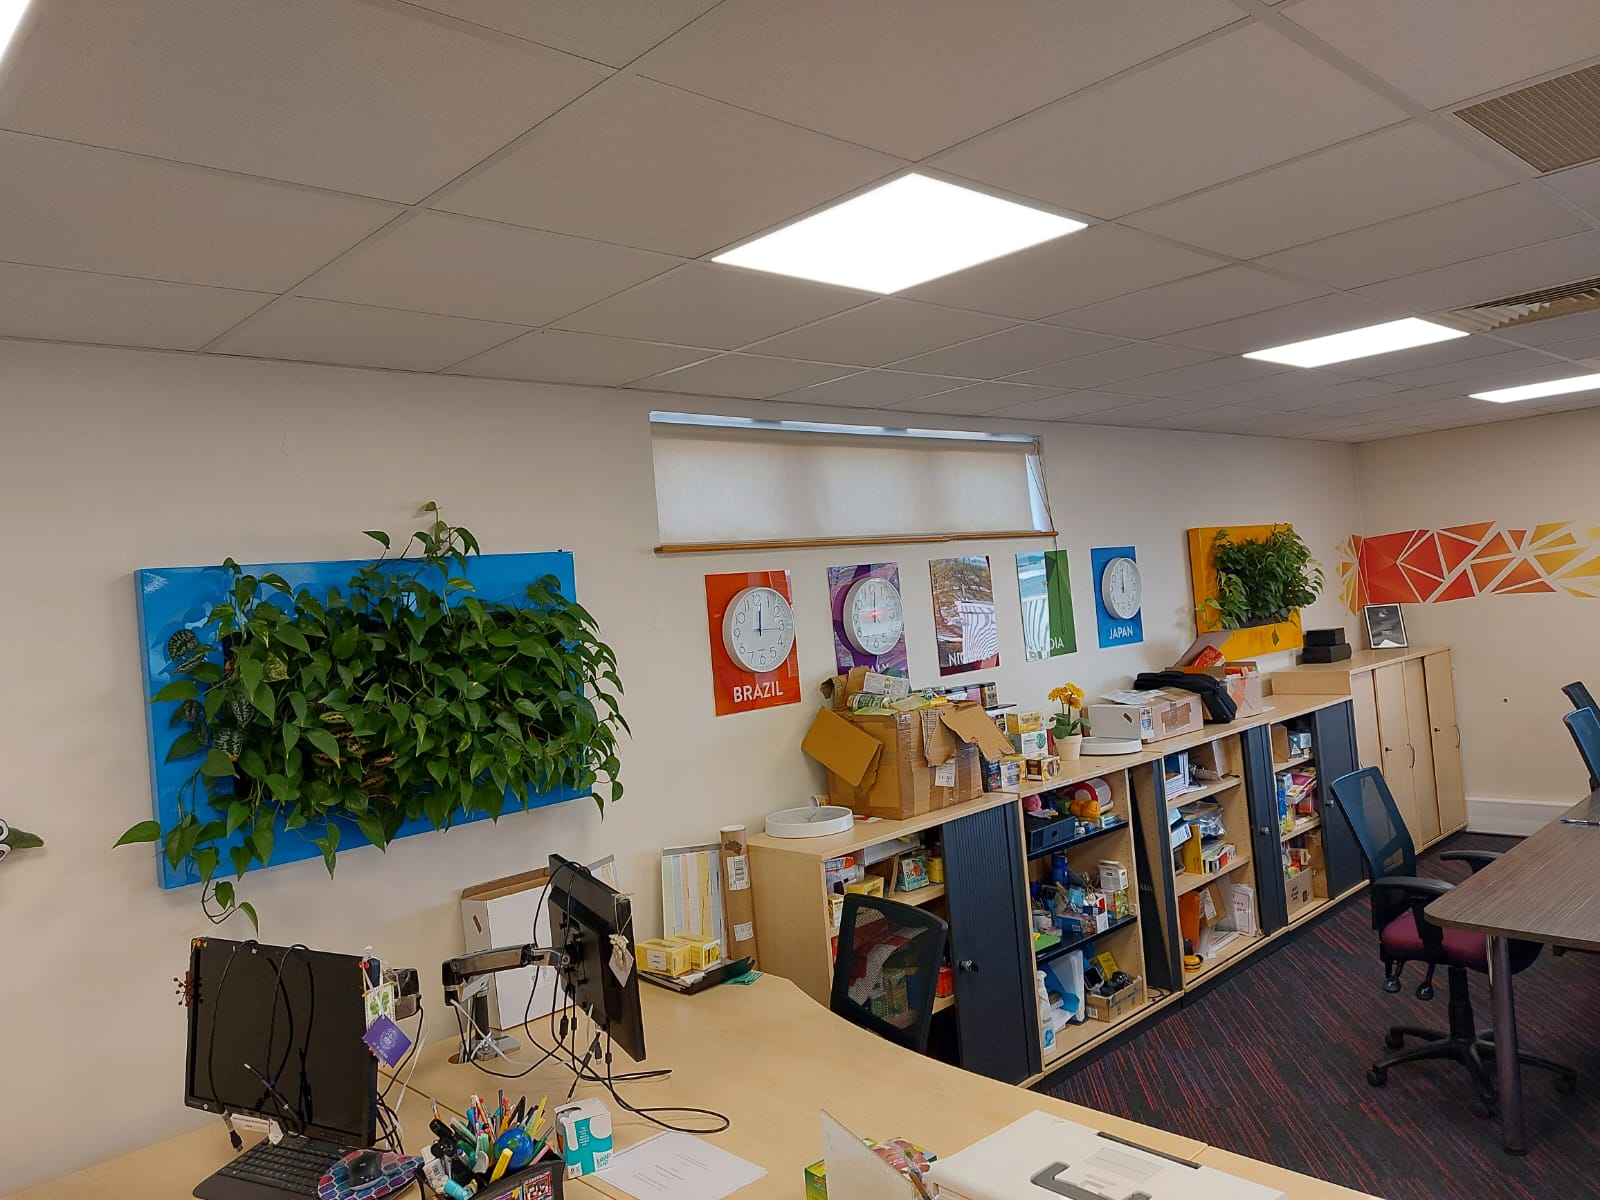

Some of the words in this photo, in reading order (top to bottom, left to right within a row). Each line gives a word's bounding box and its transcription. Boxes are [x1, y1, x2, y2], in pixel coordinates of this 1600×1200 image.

[744, 600, 750, 612] 11
[752, 594, 760, 607] 12
[735, 611, 746, 625] 10
[774, 605, 781, 618] 2
[779, 620, 785, 631] 3
[734, 628, 740, 641] 9
[1109, 625, 1134, 640] JAPAN
[740, 643, 745, 654] 8
[770, 647, 777, 658] 5
[747, 651, 755, 664] 7
[760, 653, 766, 665] 6
[733, 681, 784, 703] BRAZIL
